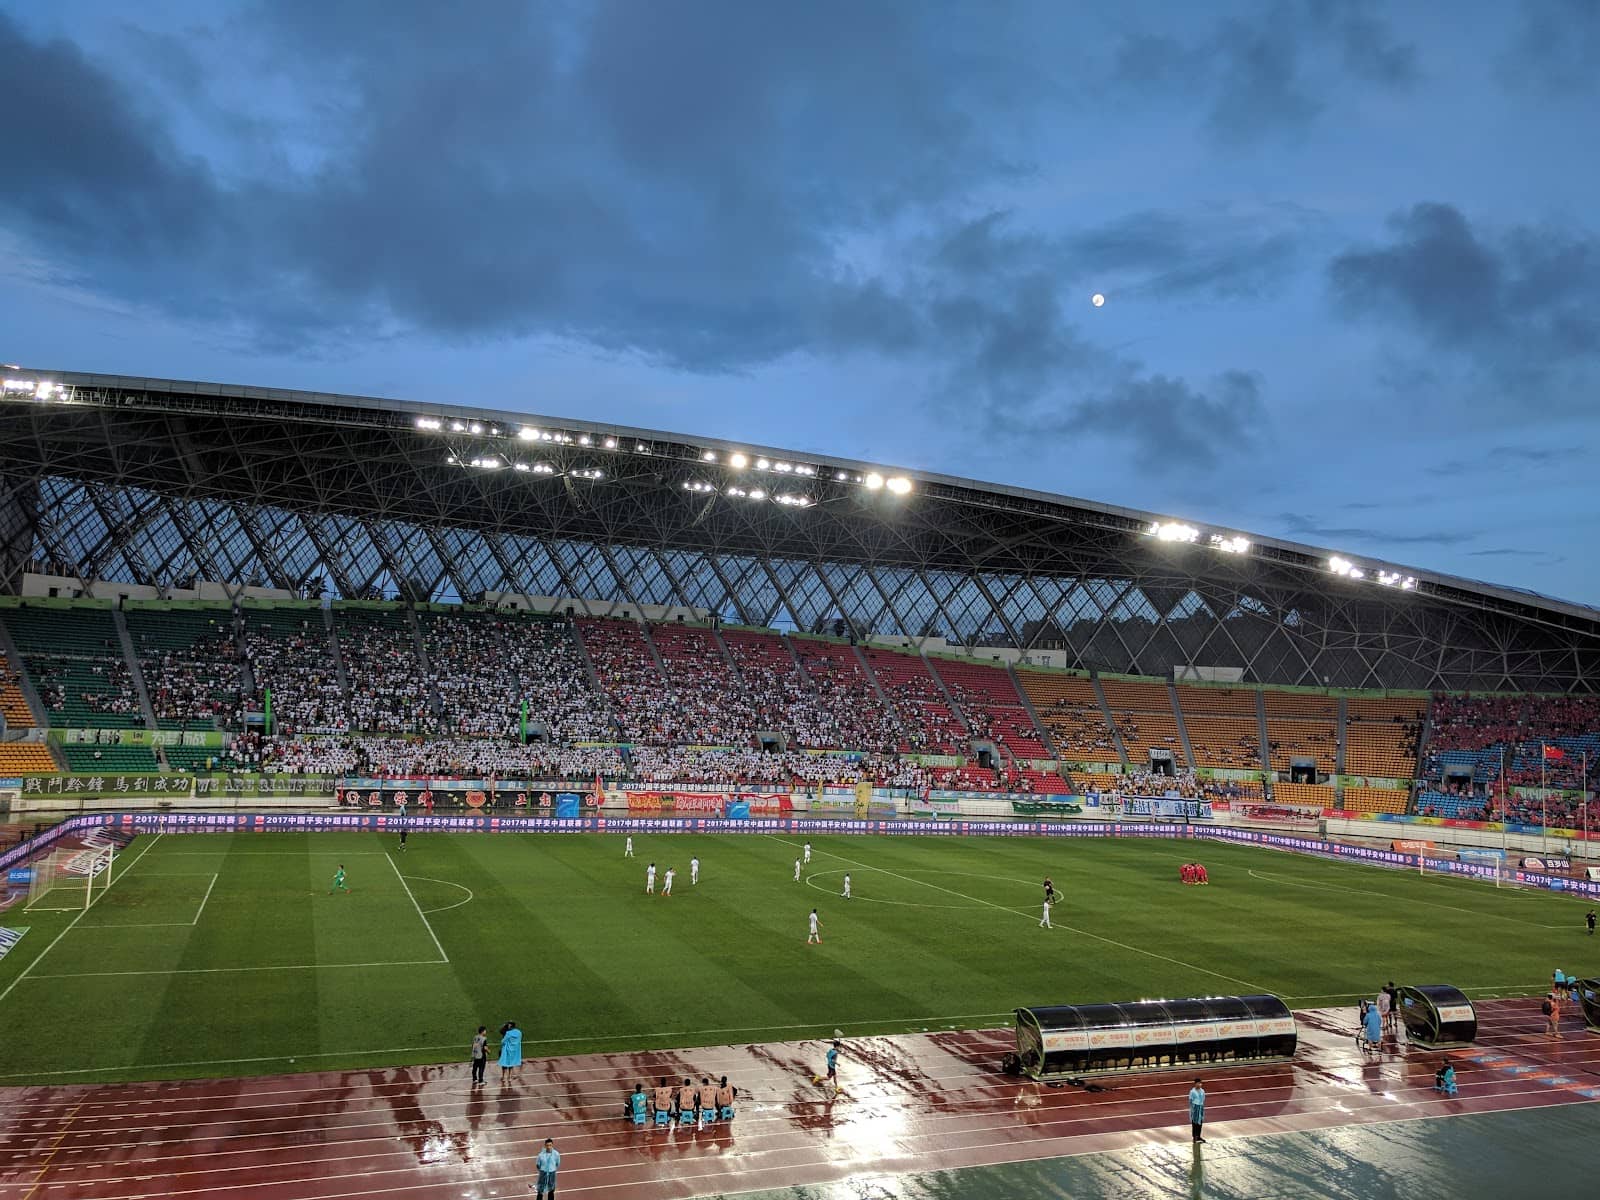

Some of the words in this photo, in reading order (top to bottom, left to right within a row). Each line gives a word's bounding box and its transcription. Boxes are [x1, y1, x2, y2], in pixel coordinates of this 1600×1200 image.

[114, 776, 189, 793] 馬到成功
[198, 778, 219, 792] WE
[222, 778, 254, 792] ARE
[135, 815, 236, 825] 2017中国平安中超联赛
[266, 815, 360, 825] 2017中国平安中超联赛
[387, 817, 475, 826] 2017中国平安中超联赛
[500, 818, 582, 827] 2017中国平安中超联赛
[607, 819, 683, 827] 2017中国平安中超联赛
[706, 820, 778, 828] 2017中国平安中超联赛
[799, 820, 867, 829] 2017中国平安中超联赛
[887, 822, 950, 830] 2017中国平安中超联赛
